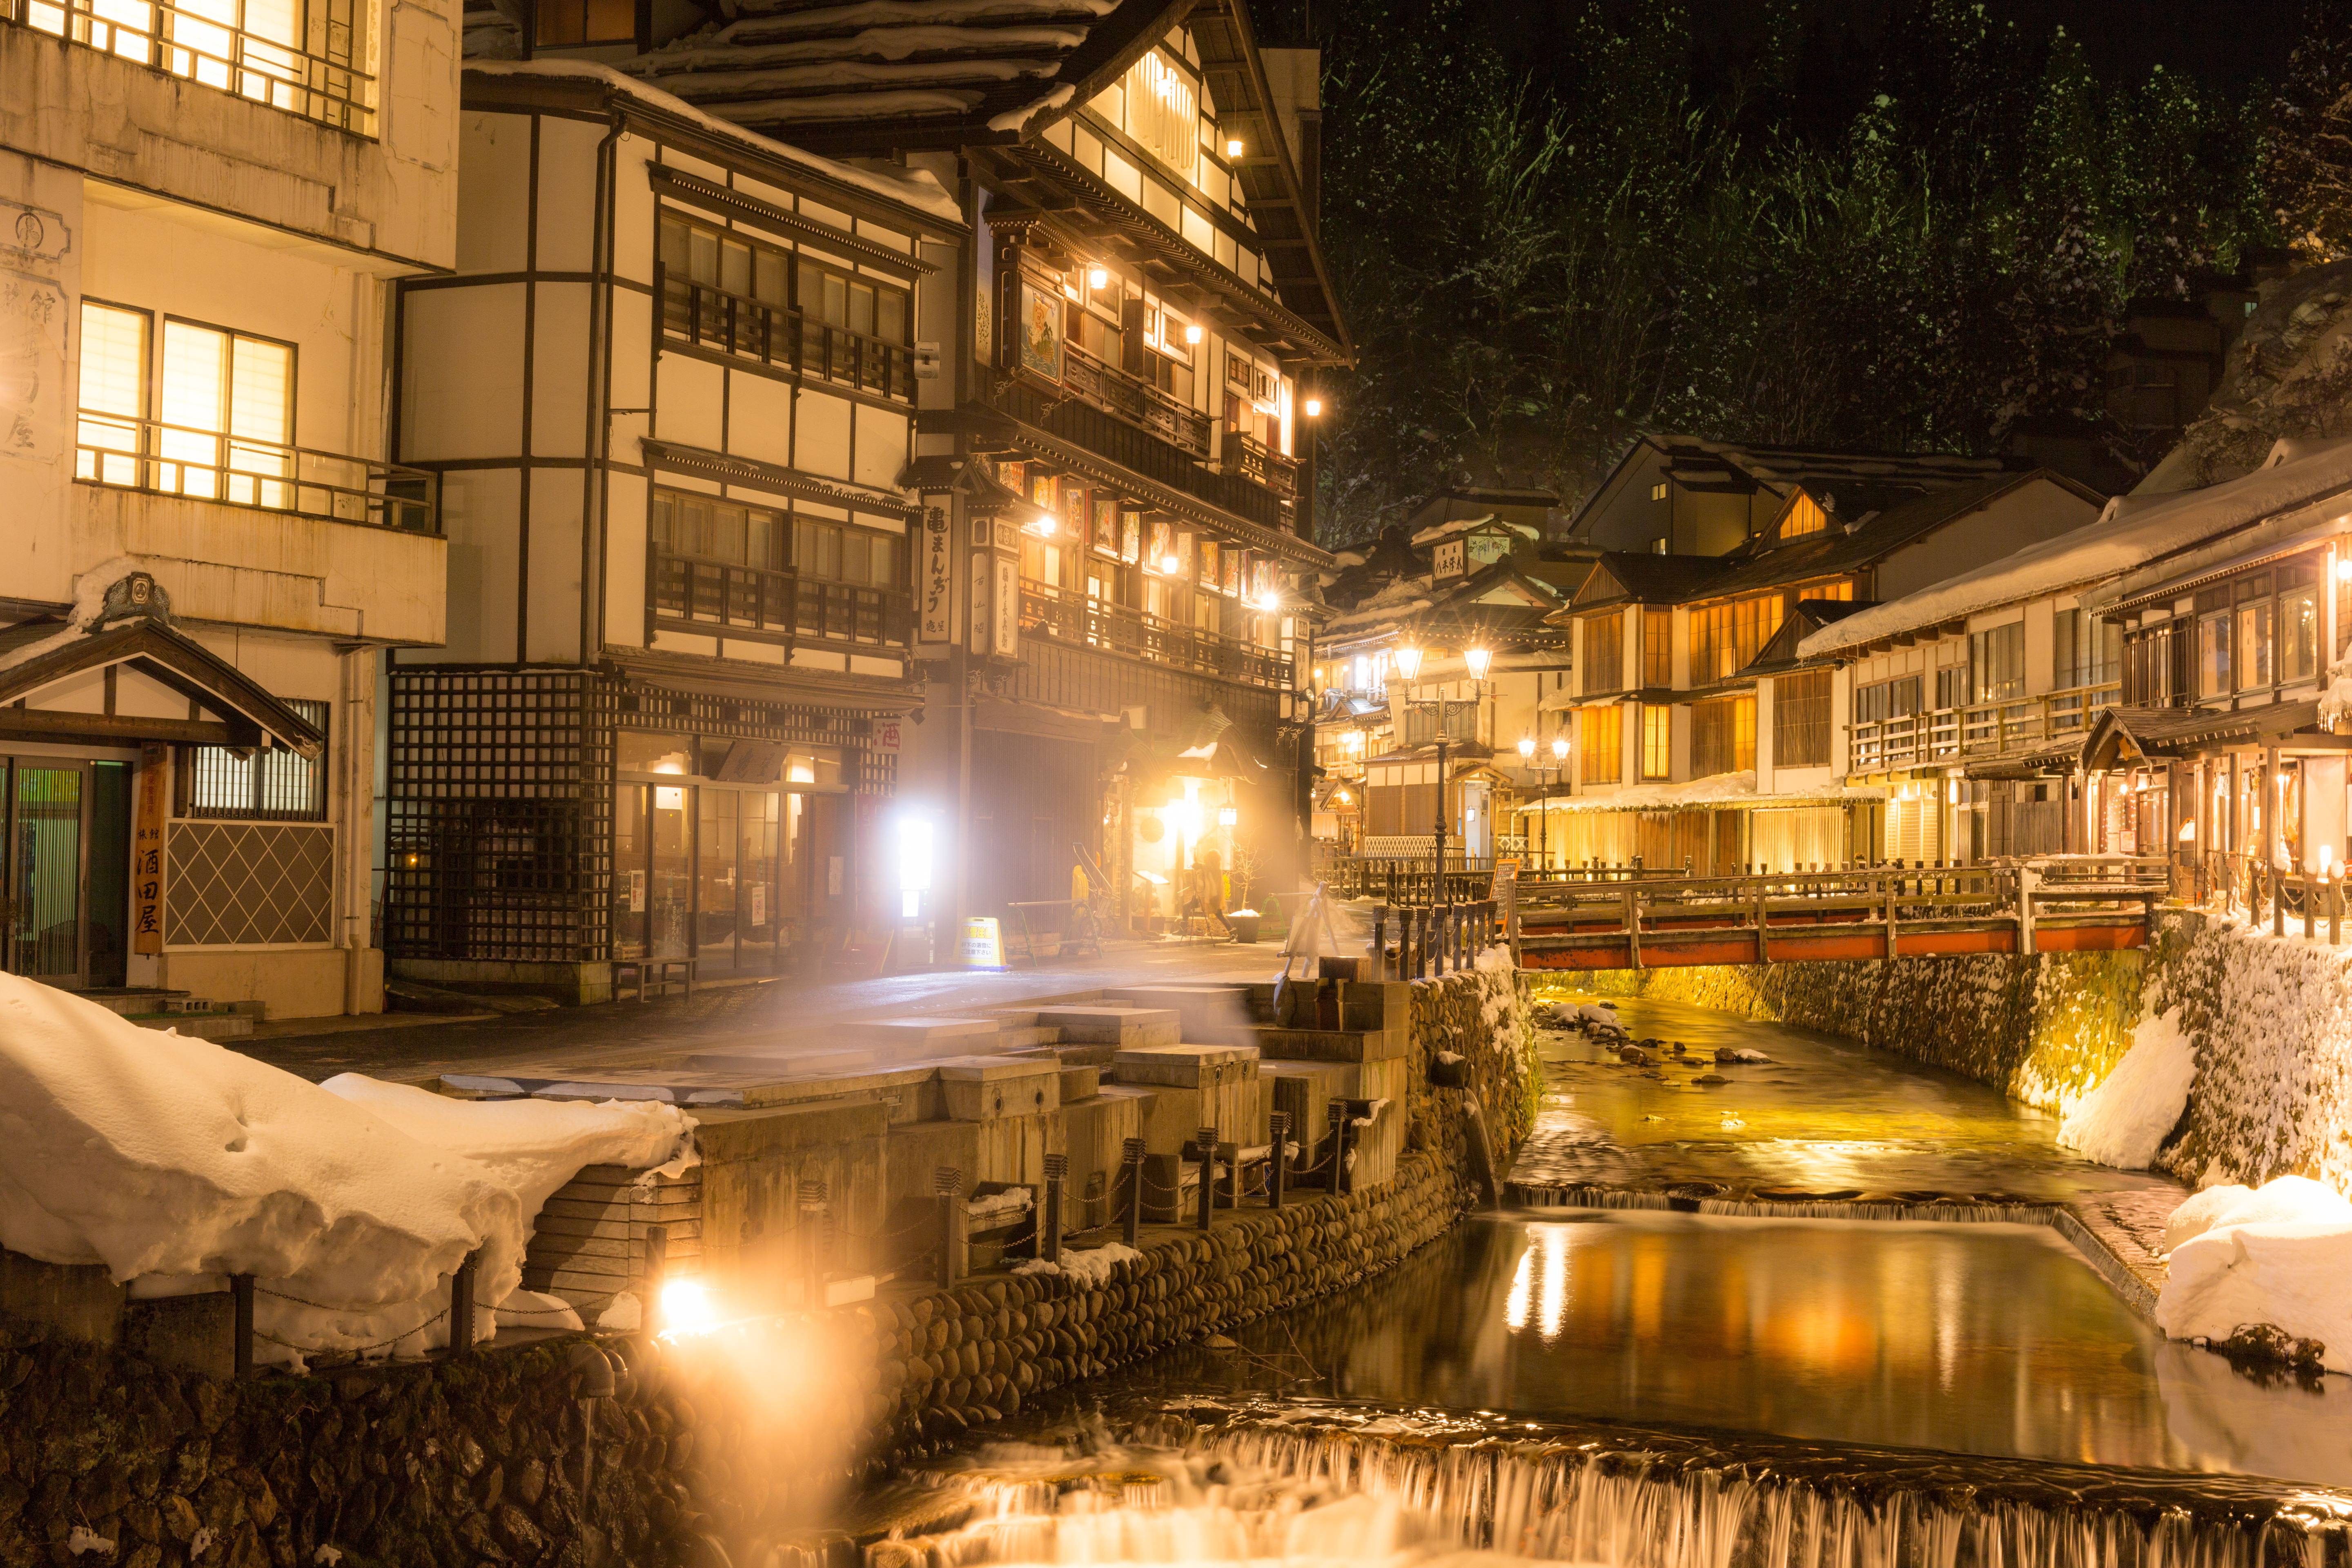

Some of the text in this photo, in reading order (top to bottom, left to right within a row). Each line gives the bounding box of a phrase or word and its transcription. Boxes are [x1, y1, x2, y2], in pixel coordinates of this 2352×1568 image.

[873, 722, 901, 751] 酒
[137, 828, 159, 840] 旅館
[135, 849, 159, 934] 酒田屋
